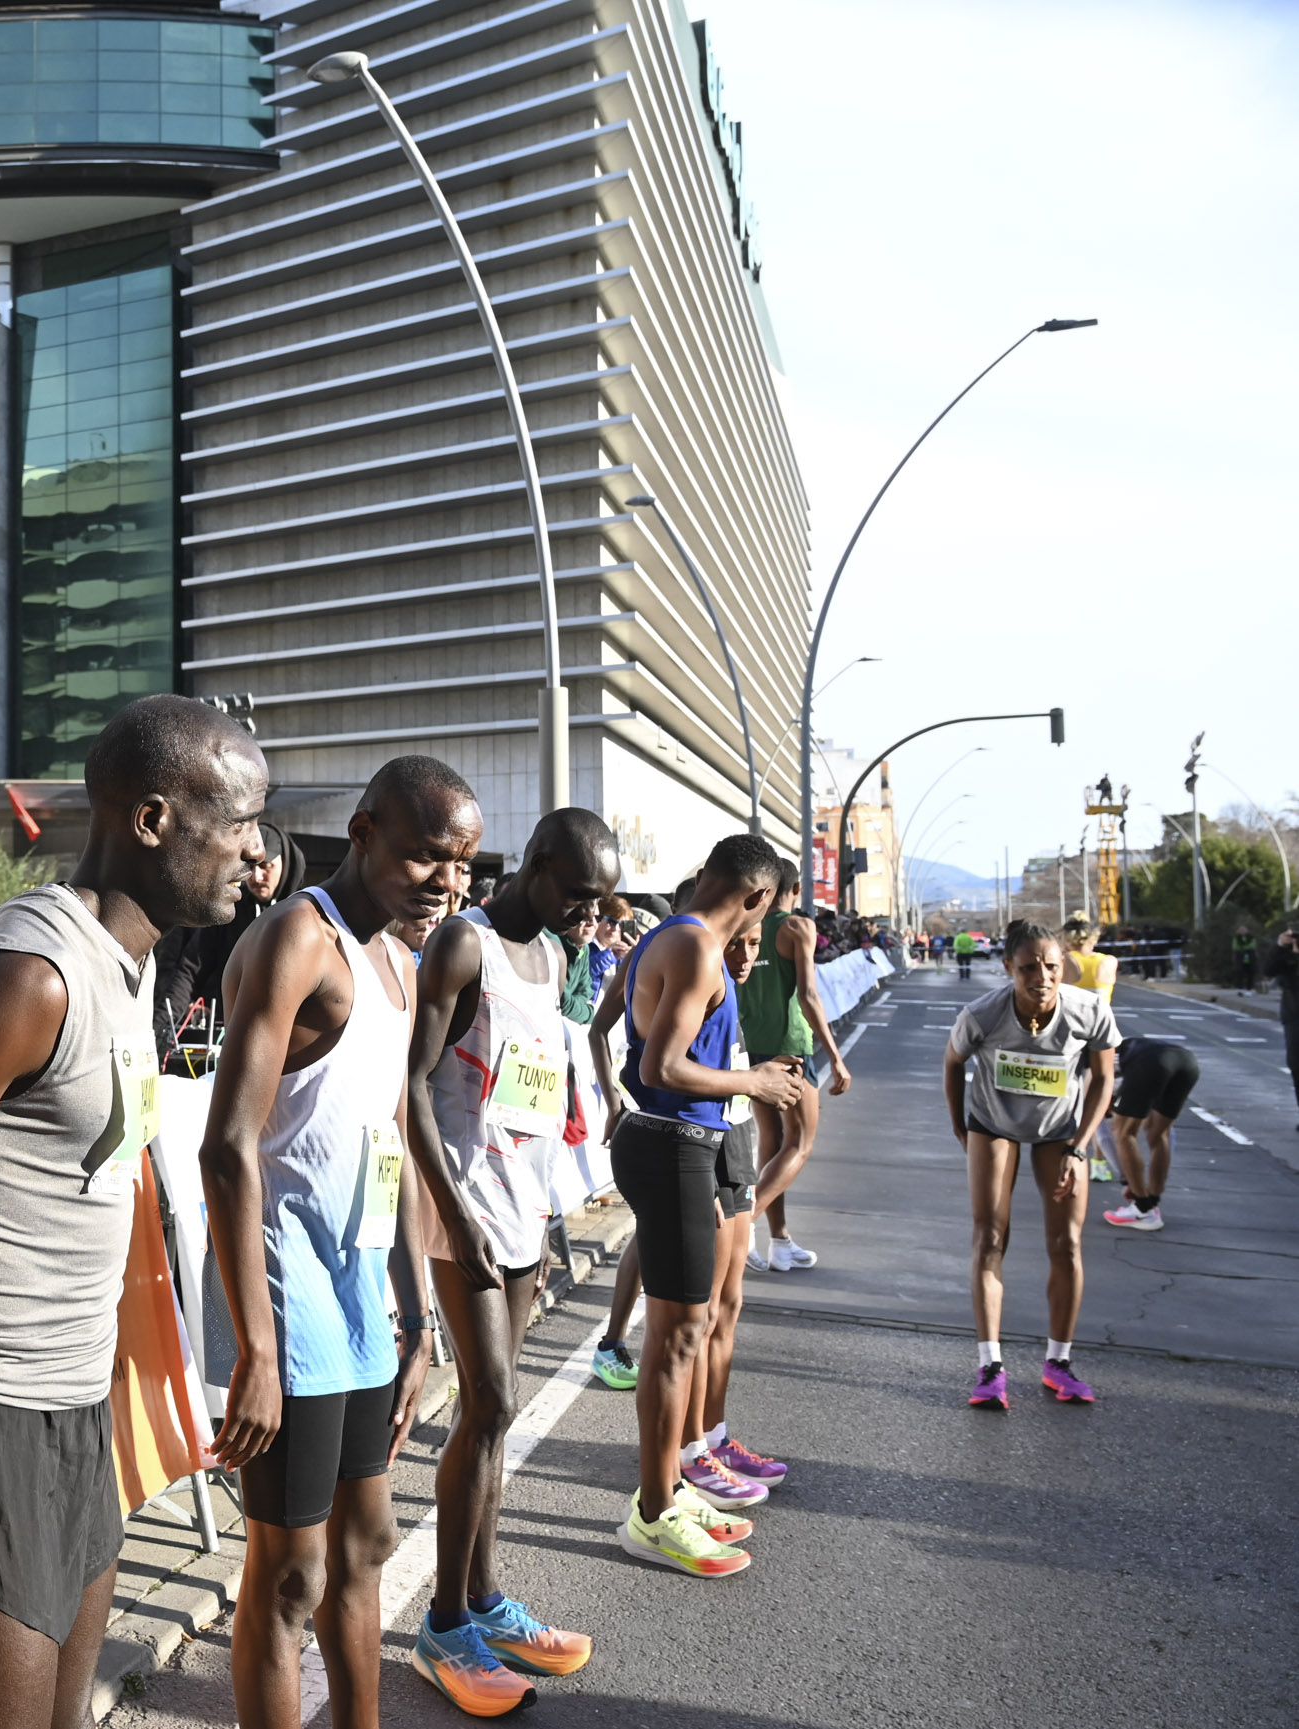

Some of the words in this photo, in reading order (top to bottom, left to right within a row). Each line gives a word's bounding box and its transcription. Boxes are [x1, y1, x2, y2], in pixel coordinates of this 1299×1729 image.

[517, 1064, 556, 1092] TUNYO
[1002, 1064, 1060, 1083] INSERMU
[1023, 1081, 1036, 1091] 21
[529, 1094, 538, 1109] 4
[664, 1121, 706, 1139] PRO
